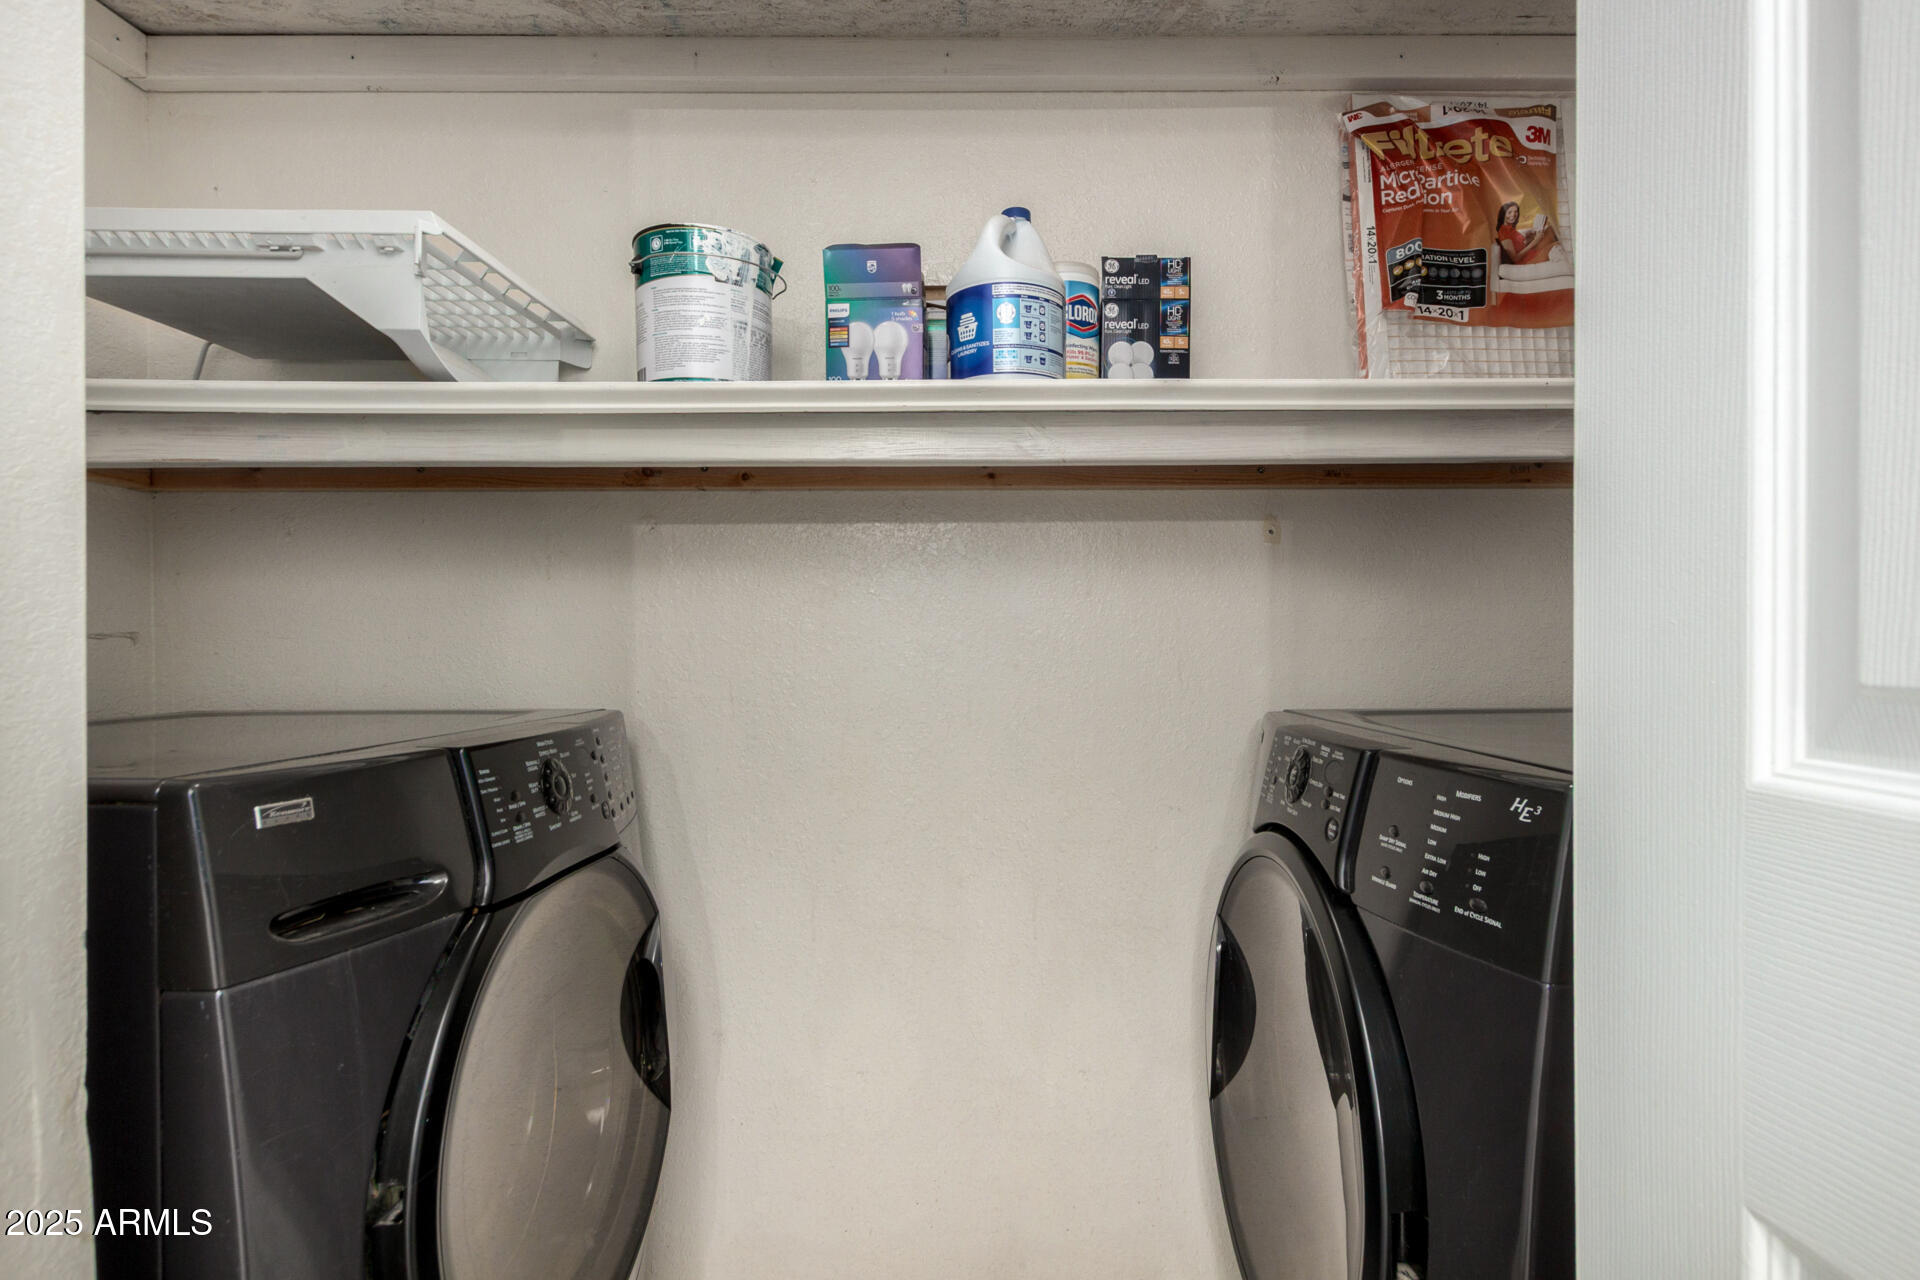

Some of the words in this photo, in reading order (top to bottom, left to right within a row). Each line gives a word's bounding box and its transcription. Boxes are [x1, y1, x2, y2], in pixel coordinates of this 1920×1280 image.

[1525, 125, 1551, 146] 3M
[1449, 255, 1474, 264] LEVEL
[1104, 274, 1137, 285] reveal
[1436, 290, 1443, 300] 3
[1104, 318, 1137, 329] reveal
[1455, 790, 1482, 802] MODIFIERS
[1427, 838, 1437, 846] LOW
[1475, 868, 1486, 877] LOW
[1472, 884, 1482, 892] OFF
[1454, 905, 1464, 915] END
[1469, 910, 1485, 922] CYCLE
[1484, 915, 1502, 929] SIGNAL
